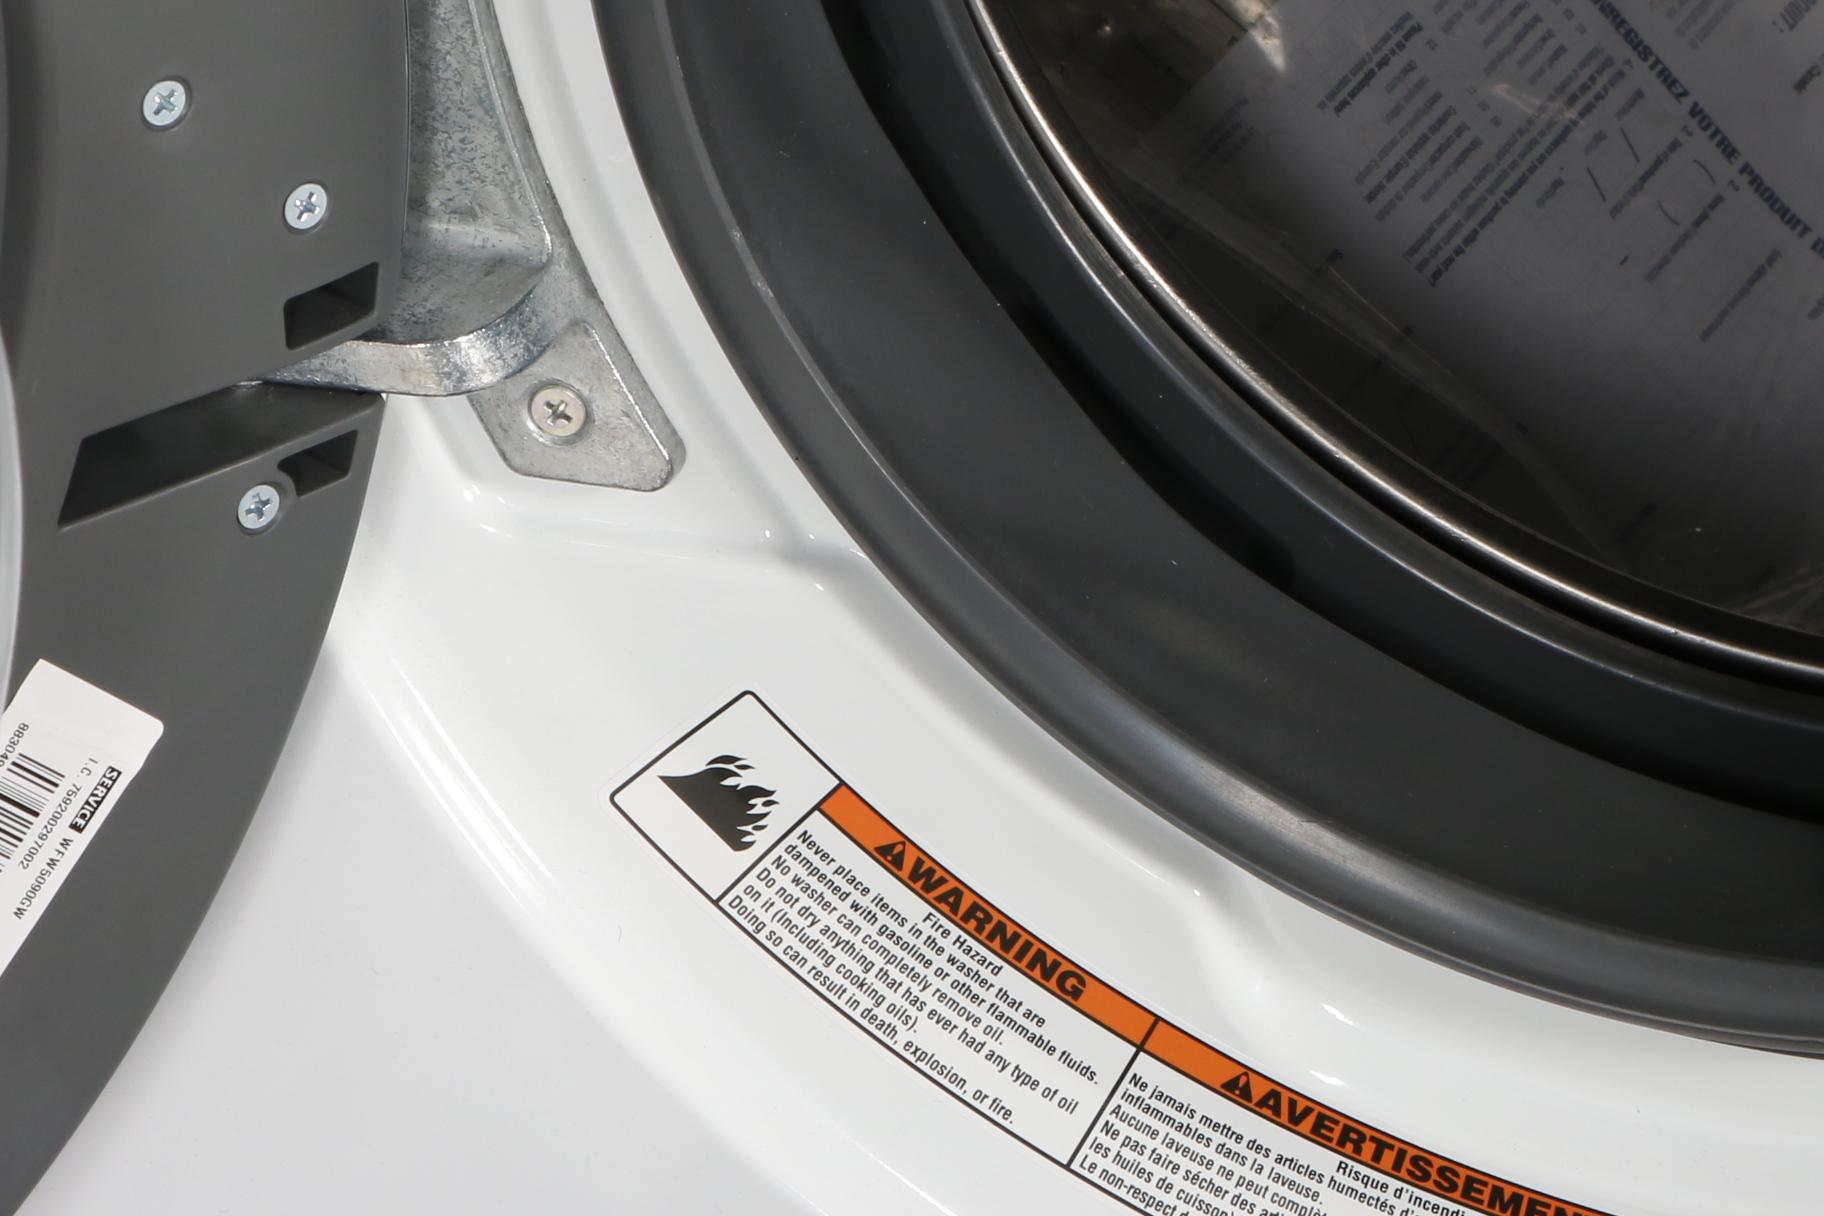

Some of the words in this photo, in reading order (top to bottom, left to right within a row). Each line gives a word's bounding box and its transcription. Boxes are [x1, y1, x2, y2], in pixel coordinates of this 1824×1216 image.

[1688, 102, 1741, 164] VOTRE
[1740, 162, 1814, 239] PRODUIT
[19, 783, 81, 869] 759200297002
[72, 766, 117, 828] SERVICE
[13, 838, 73, 919] WFW5090GW
[770, 854, 791, 876] No
[790, 873, 838, 915] washer
[836, 913, 862, 937] can
[861, 934, 933, 993] completely
[931, 987, 982, 1028] remove
[982, 1024, 1004, 1045] oil.
[796, 829, 836, 866] Never
[831, 864, 870, 897] place
[870, 892, 908, 928] items
[907, 922, 923, 940] in
[922, 934, 945, 956] the
[946, 953, 995, 992] washer
[994, 986, 1023, 1012] that
[1022, 1008, 1046, 1028] are
[909, 856, 1086, 1001] WARNING
[921, 911, 951, 939] Fire
[952, 934, 1004, 977] Hazard
[727, 894, 767, 934] Doing
[765, 929, 783, 947] so
[782, 944, 808, 968] can
[806, 965, 847, 1000] result
[844, 992, 860, 1011] in
[859, 1007, 898, 1045] death,
[902, 1040, 967, 1095] explosion,
[972, 1089, 989, 1104] or
[988, 1097, 1013, 1124] fire.
[743, 884, 762, 902] on
[760, 897, 775, 913] it
[770, 908, 836, 968] (Including
[835, 963, 886, 1008] cooking
[885, 1002, 918, 1033] oils).
[756, 866, 776, 889] Do
[774, 886, 800, 909] not
[796, 905, 821, 928] dry
[819, 924, 875, 974] anything
[874, 966, 903, 994] that
[900, 986, 927, 1012] has
[926, 1008, 959, 1034] ever
[957, 1027, 987, 1054] had
[984, 1049, 1011, 1073] any
[1010, 1063, 1040, 1091] type
[1041, 1086, 1059, 1102] of
[1057, 1096, 1079, 1115] oil
[783, 844, 852, 902] dampened
[849, 899, 878, 926] with
[875, 923, 933, 969] gasoline
[933, 966, 951, 981] or
[950, 978, 987, 1007] other
[985, 1002, 1057, 1056] flammable
[1057, 1050, 1098, 1084] fluids.
[1120, 1087, 1213, 1148] inflammables
[1214, 1142, 1248, 1167] dans
[1249, 1157, 1264, 1175] la
[1267, 1166, 1322, 1205] laveuse.
[1128, 1072, 1148, 1092] Ne
[1147, 1085, 1197, 1120] jamais
[1198, 1114, 1244, 1145] mettre
[1245, 1138, 1272, 1159] des
[1274, 1153, 1325, 1184] articles
[1327, 1175, 1396, 1216] humectés
[1335, 1159, 1389, 1194] Risque
